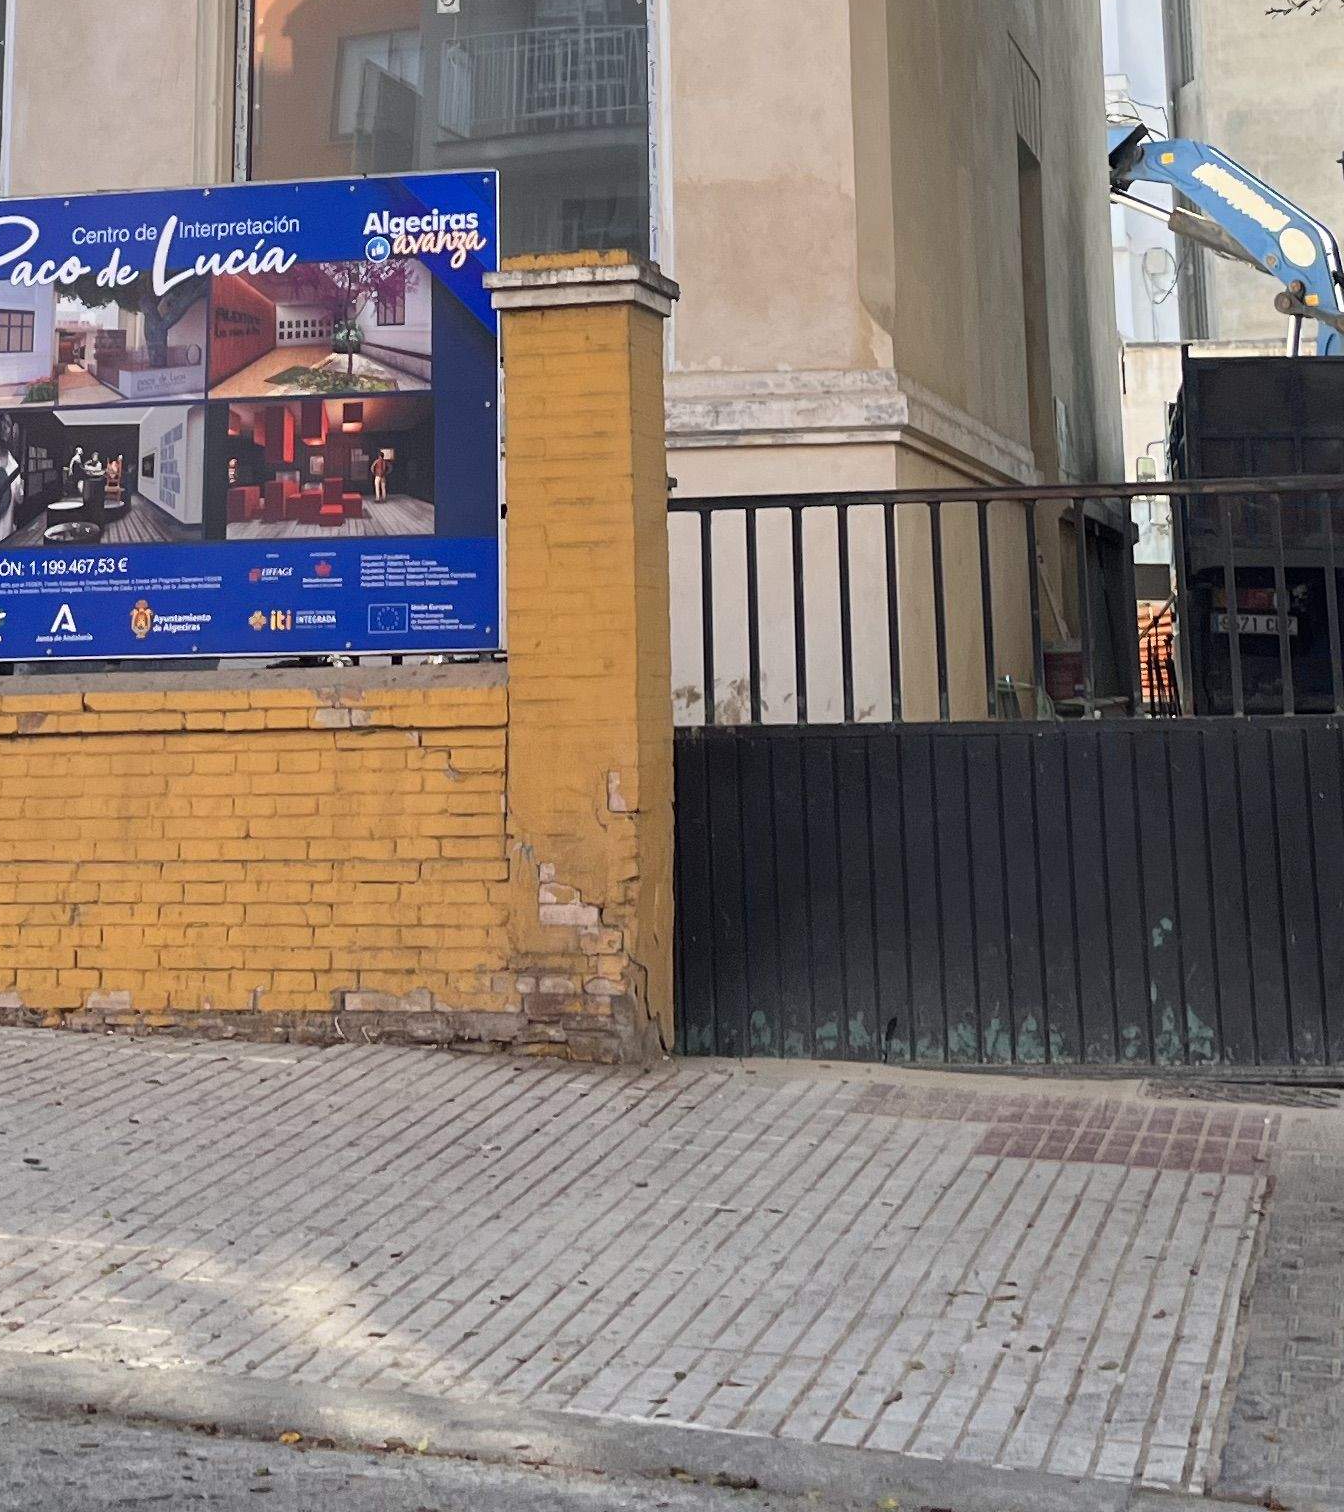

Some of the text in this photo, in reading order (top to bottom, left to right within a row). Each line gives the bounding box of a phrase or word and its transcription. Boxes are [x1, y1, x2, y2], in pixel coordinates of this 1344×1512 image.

[72, 216, 300, 245] Centro de Interpretación
[363, 208, 479, 237] Algeciras
[96, 248, 139, 287] de
[152, 215, 297, 297] Lucía
[392, 230, 487, 269] avanza
[29, 558, 115, 577] 1.199.467,53
[118, 557, 128, 573] €
